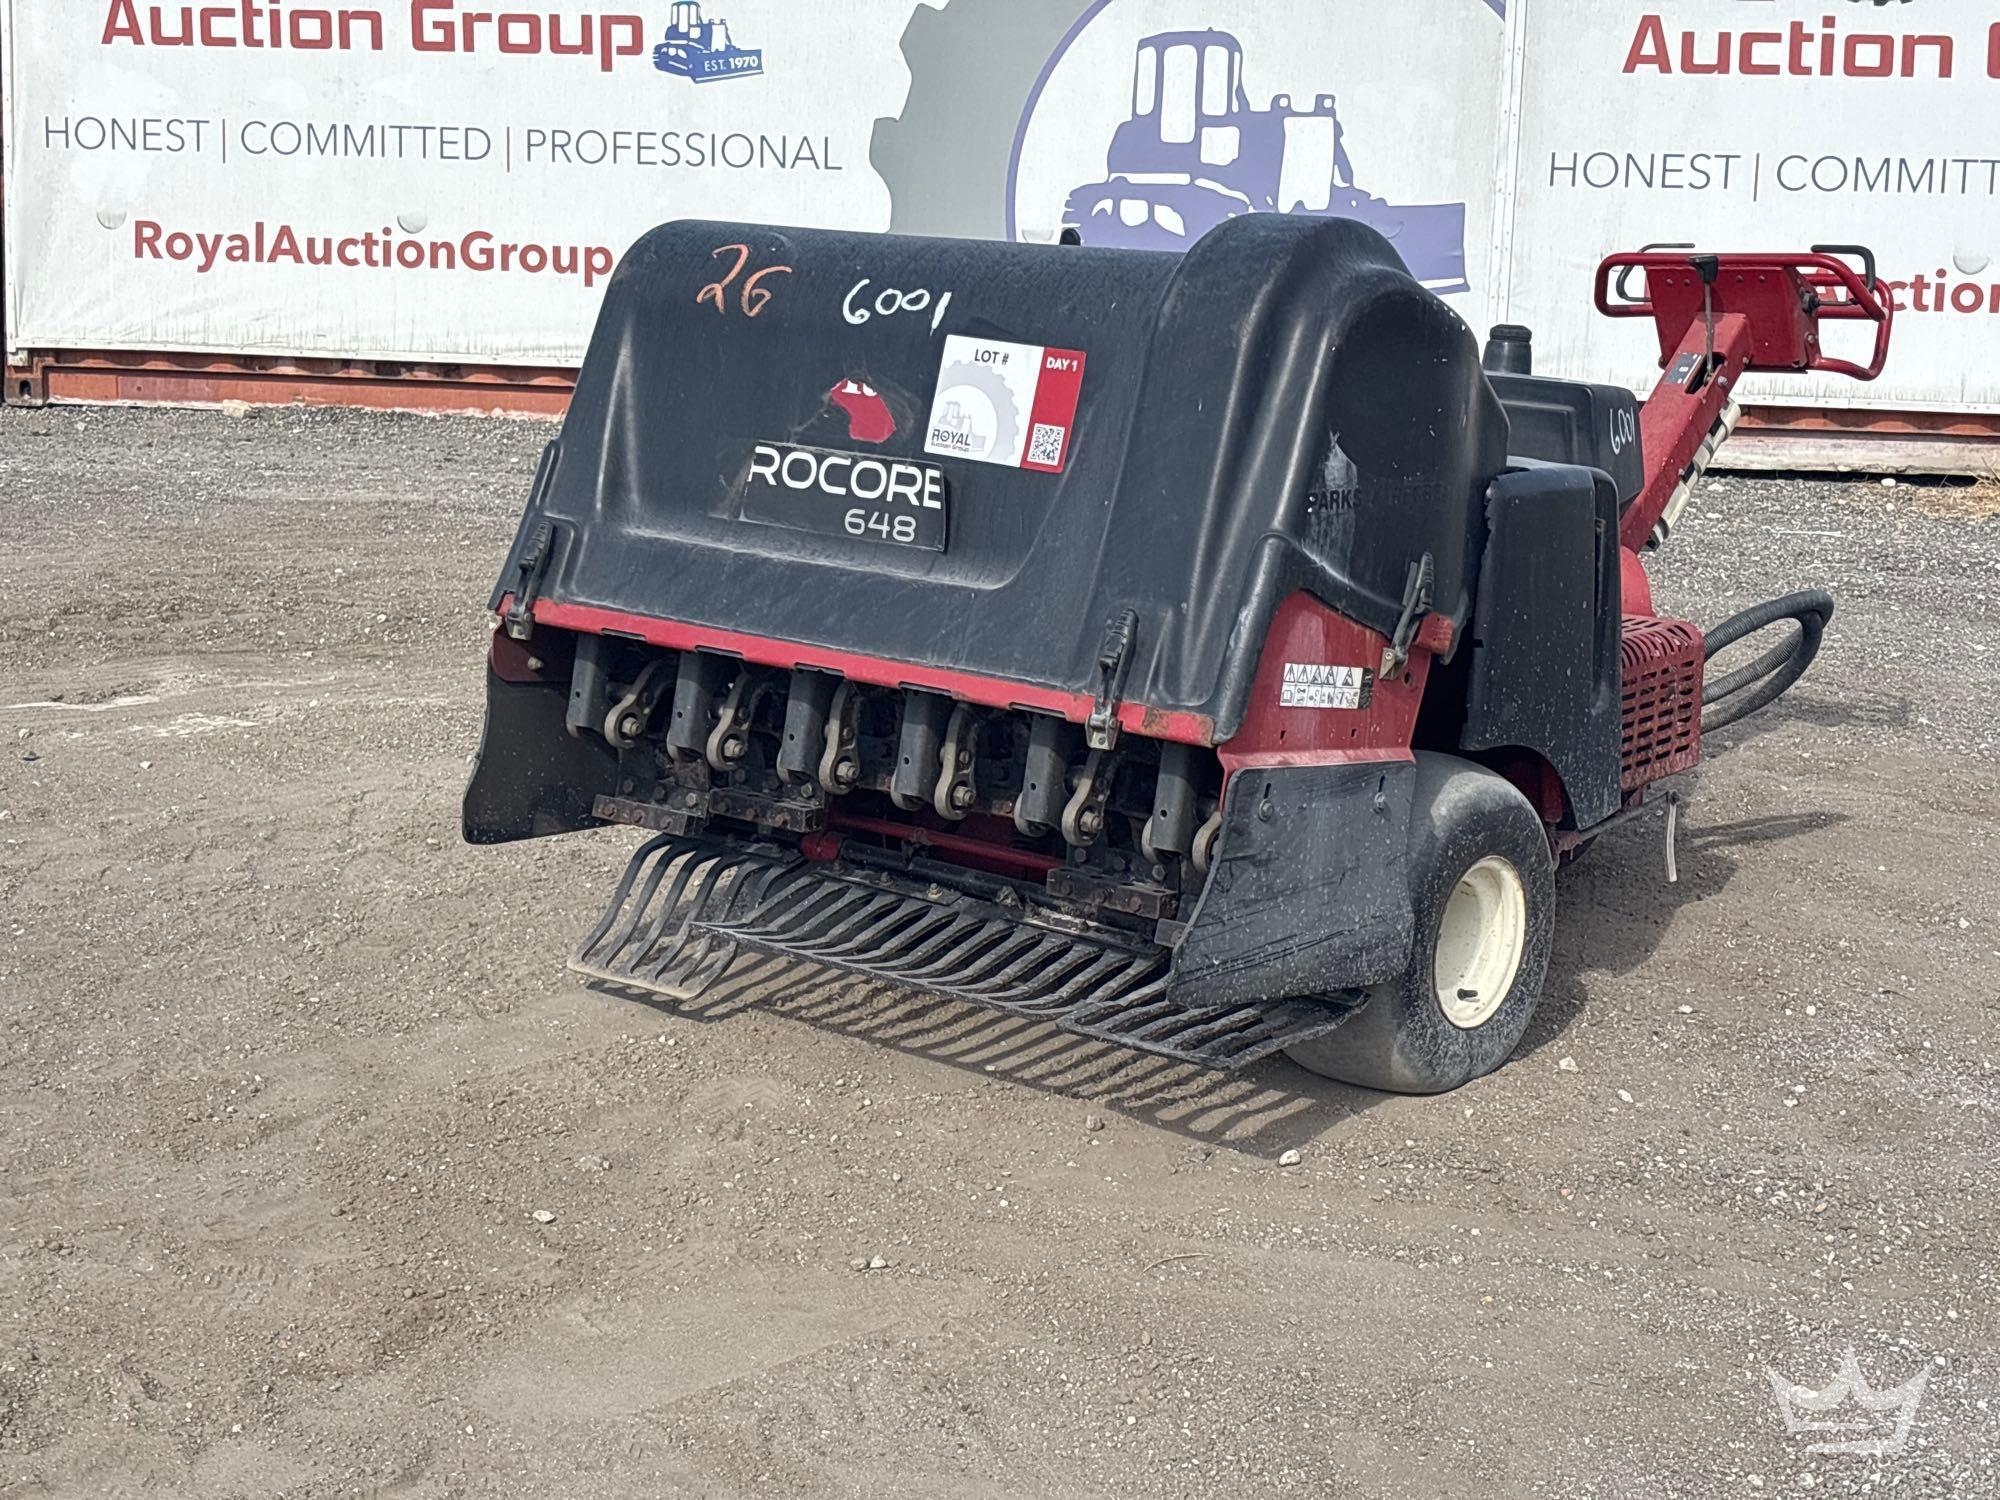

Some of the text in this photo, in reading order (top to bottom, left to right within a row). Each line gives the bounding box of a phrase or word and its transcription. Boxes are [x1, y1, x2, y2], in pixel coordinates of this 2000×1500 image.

[101, 0, 644, 72] Auction Group
[1622, 15, 1954, 78] Auction
[704, 56, 759, 72] EST. 1970
[45, 116, 842, 170] HONEST COMMITTED PROFESSIONAL
[1549, 152, 1741, 189] HONEST
[134, 220, 614, 287] RoyalAuctionGroup
[842, 279, 952, 335] 6001
[974, 349, 999, 364] LOT
[1046, 356, 1078, 372] DAY 1
[932, 429, 971, 446] ROYAL
[1609, 406, 1636, 455] 6001
[747, 446, 942, 509] ROCORE
[844, 508, 916, 542] 648
